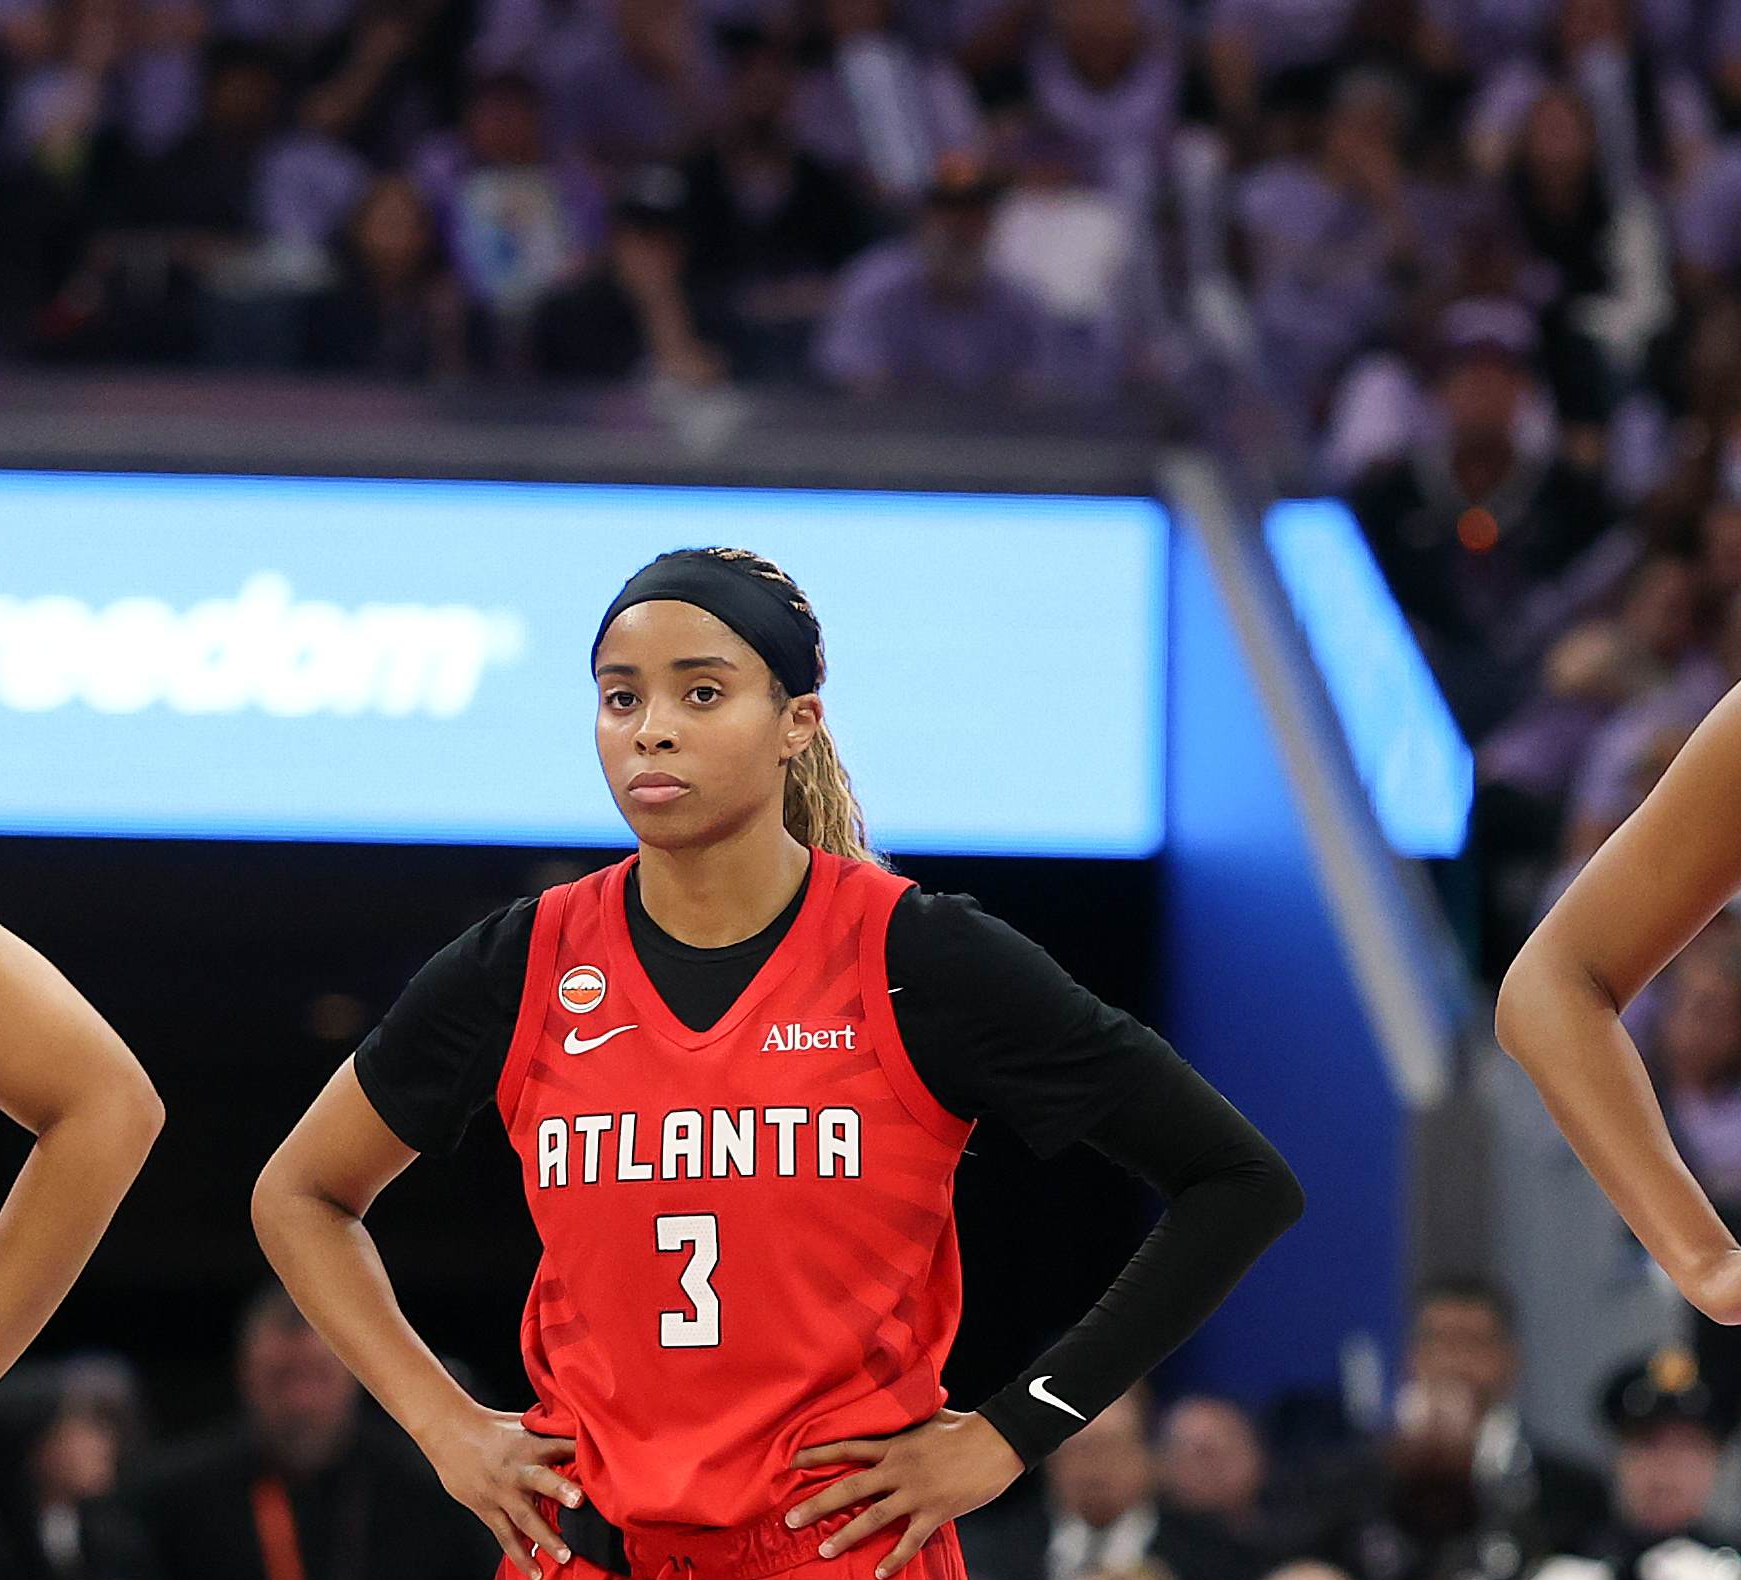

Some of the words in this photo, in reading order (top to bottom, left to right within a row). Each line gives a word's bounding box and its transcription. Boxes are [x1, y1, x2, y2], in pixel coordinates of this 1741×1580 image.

[760, 1021, 857, 1054] Albert
[536, 1106, 861, 1190] ATLANTA
[654, 1213, 721, 1349] 3
